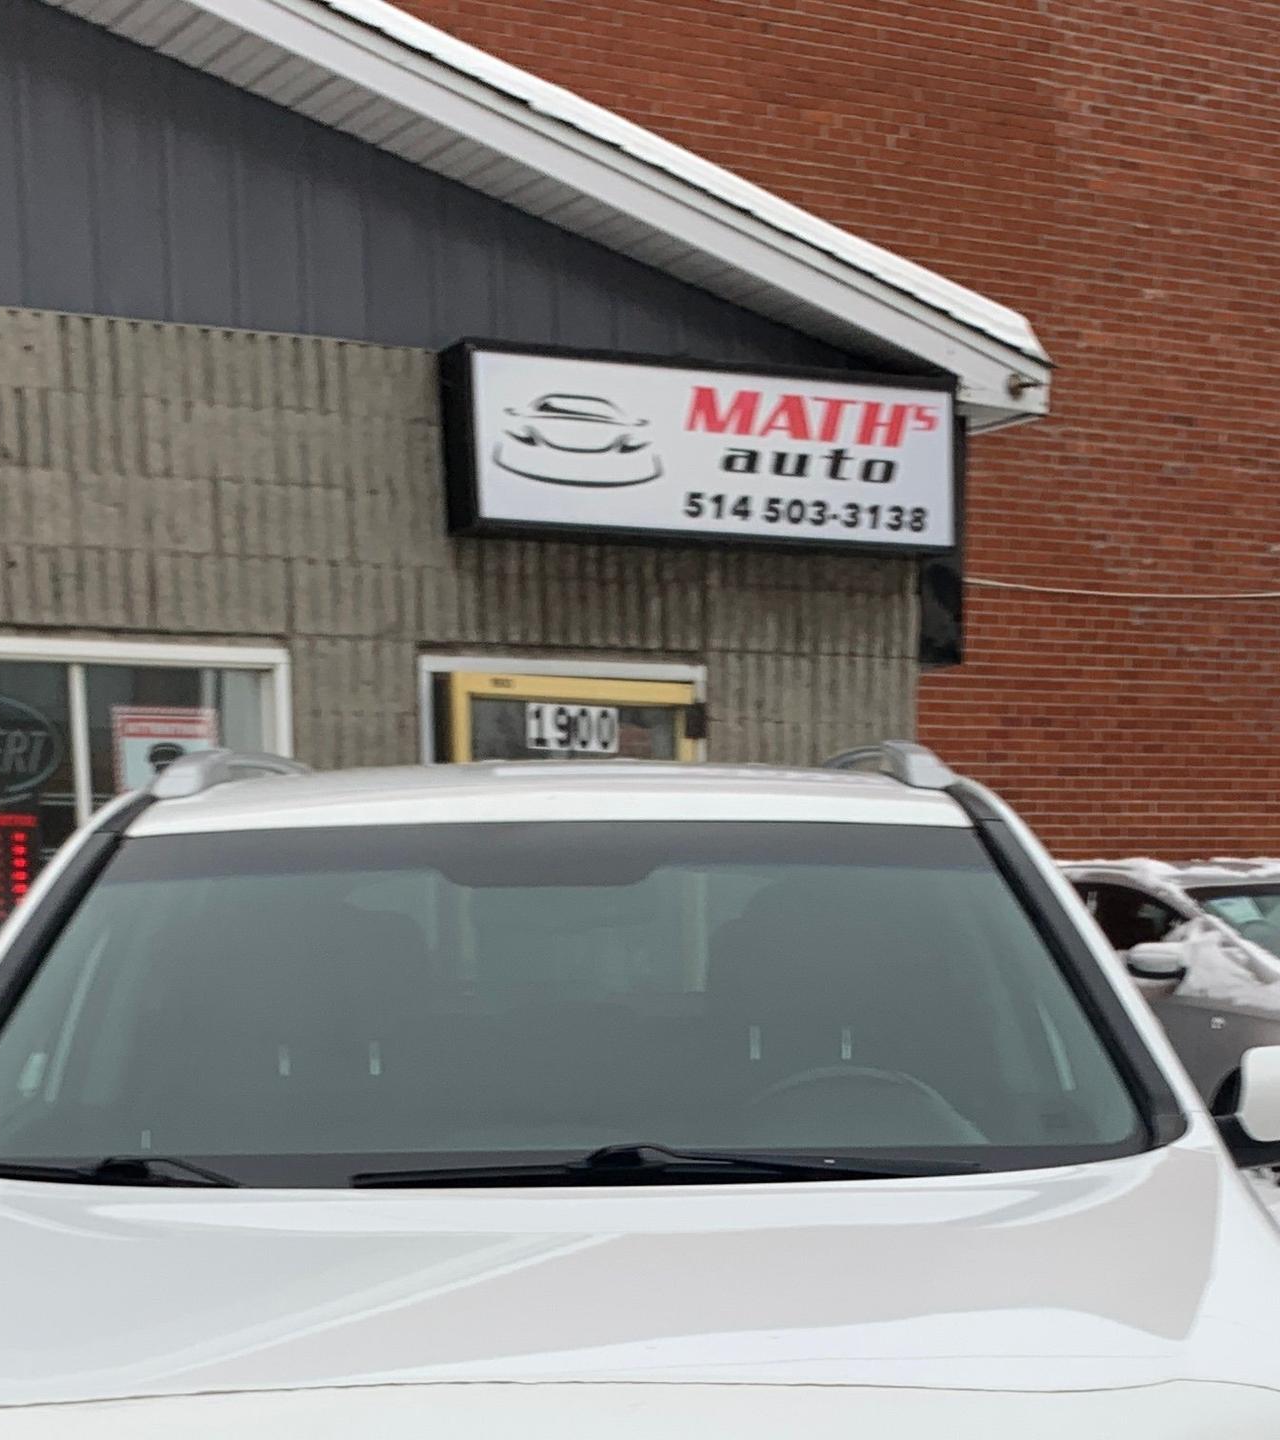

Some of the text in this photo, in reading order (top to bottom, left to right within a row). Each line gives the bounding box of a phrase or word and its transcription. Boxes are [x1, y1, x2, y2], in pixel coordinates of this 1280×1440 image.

[723, 448, 897, 484] auto
[684, 491, 927, 533] 514 503-3138
[531, 706, 616, 748] 1900
